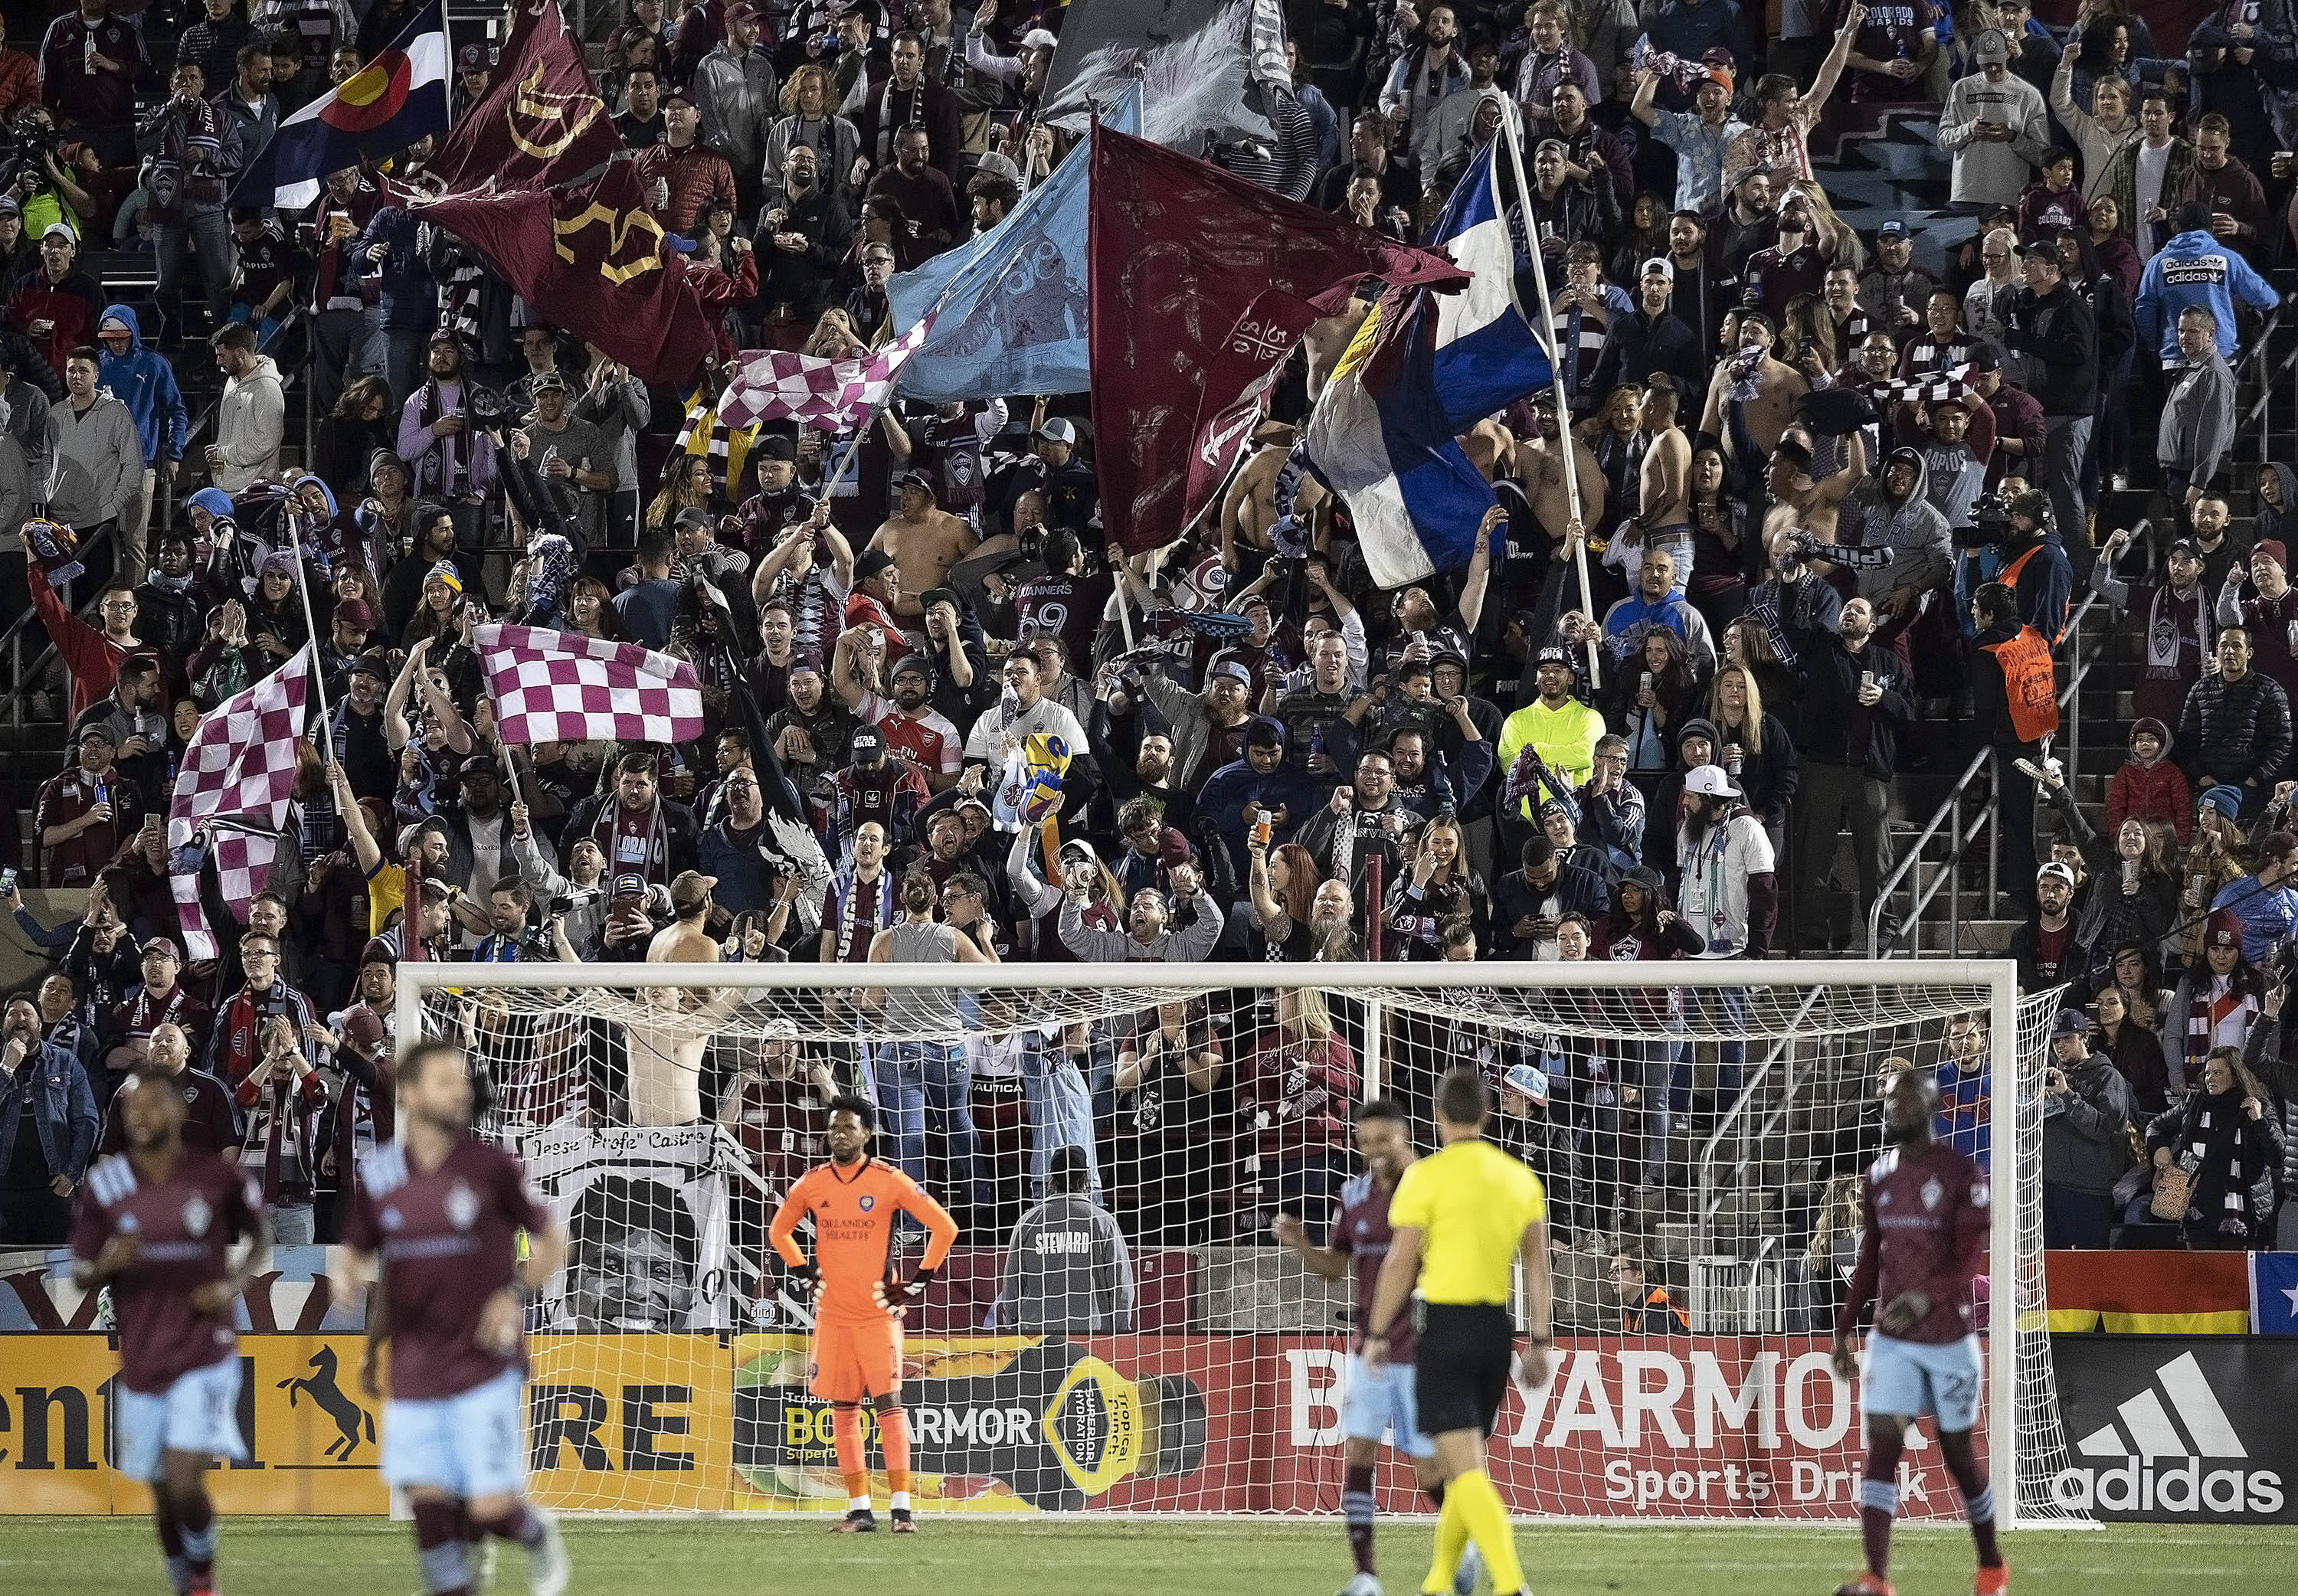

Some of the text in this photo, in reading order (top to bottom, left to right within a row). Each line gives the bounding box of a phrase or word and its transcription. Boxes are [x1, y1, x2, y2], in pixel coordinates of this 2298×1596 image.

[1866, 6, 1913, 21] COLORADO
[1867, 18, 1913, 28] RAPIDS
[2038, 214, 2071, 226] COLORADO
[2165, 259, 2208, 271] adidas
[2166, 270, 2208, 284] adidas
[1924, 448, 1968, 473] RAPIDS
[1017, 600, 1068, 642] 69
[853, 741, 878, 749] WARS
[1390, 783, 1426, 795] RONCOS
[1704, 782, 1713, 791] C
[532, 1140, 580, 1160] Jesse
[649, 1132, 707, 1149] Castro
[820, 1219, 876, 1228] ORLANDO
[827, 1231, 870, 1240] HEALTH
[1036, 1231, 1089, 1254] STEWARD
[751, 1307, 776, 1319] 2020
[1285, 1350, 1927, 1450] BYARMO
[1074, 1388, 1085, 1461] HYDRATION
[1085, 1388, 1096, 1461] SUPERIOR
[1108, 1399, 1119, 1456] Punch
[1117, 1390, 1131, 1464] Tropical
[1606, 1460, 1929, 1510] Sports Drik
[2053, 1455, 2285, 1513] adidas
